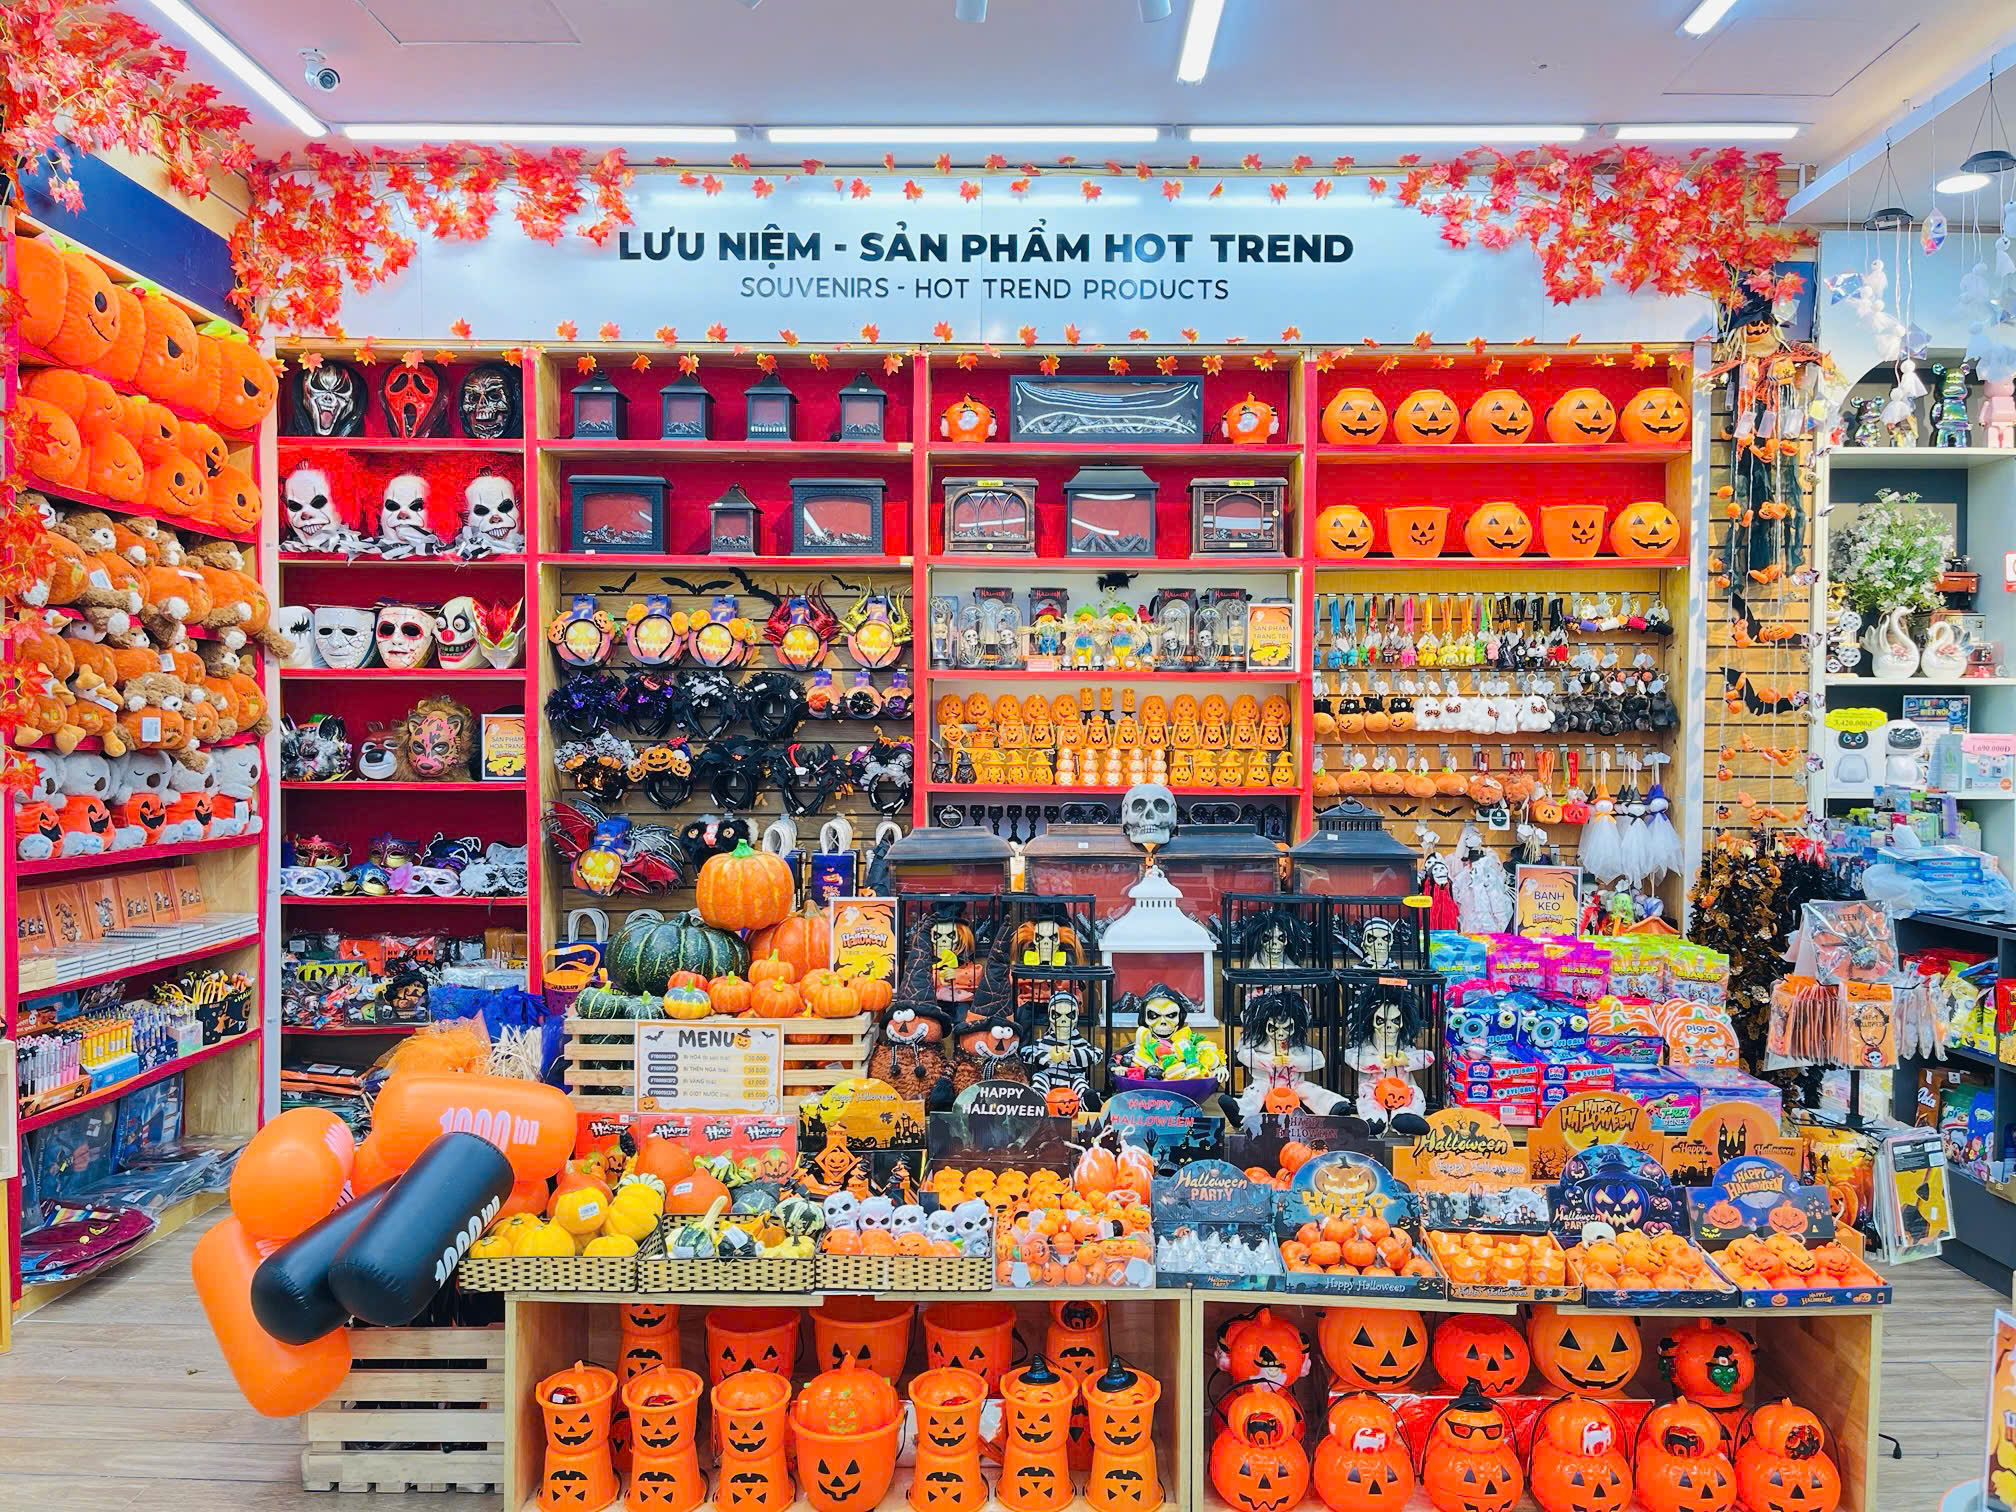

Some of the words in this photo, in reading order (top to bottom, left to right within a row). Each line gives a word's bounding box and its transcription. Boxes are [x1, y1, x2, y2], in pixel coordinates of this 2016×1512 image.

[619, 226, 705, 261] LƯU
[718, 223, 821, 270] NIỆM
[834, 243, 847, 251] -
[859, 221, 948, 262] SẢN
[961, 218, 1090, 263] PHẨM
[1105, 232, 1193, 264] HOT
[1210, 233, 1354, 264] TREND
[740, 276, 889, 298] SOUVENIRS
[915, 278, 969, 299] HOT
[982, 278, 1071, 300] TREND
[1083, 278, 1229, 300] PRODUCTS
[678, 1029, 735, 1048] MENU
[979, 1086, 1025, 1099] HAPPY
[962, 1103, 1045, 1117] HALLOWEEN
[1128, 1098, 1174, 1110] HAPPY
[1584, 1099, 1622, 1114] HAPPY
[1111, 1115, 1195, 1128] HALLOWEEN
[1560, 1105, 1638, 1132] HALLOWEEN
[746, 1126, 784, 1139] HAPPY
[1413, 1129, 1508, 1158] Halloween
[1174, 1168, 1248, 1191] Halloween
[1734, 1167, 1767, 1183] HAPPY
[1190, 1187, 1234, 1201] PARTY
[1723, 1174, 1785, 1200] HALLOWEEN
[1553, 1208, 1601, 1224] Halloween
[1564, 1220, 1585, 1230] PART
[1325, 1277, 1354, 1294] Happy
[1356, 1278, 1406, 1293] Halloween
